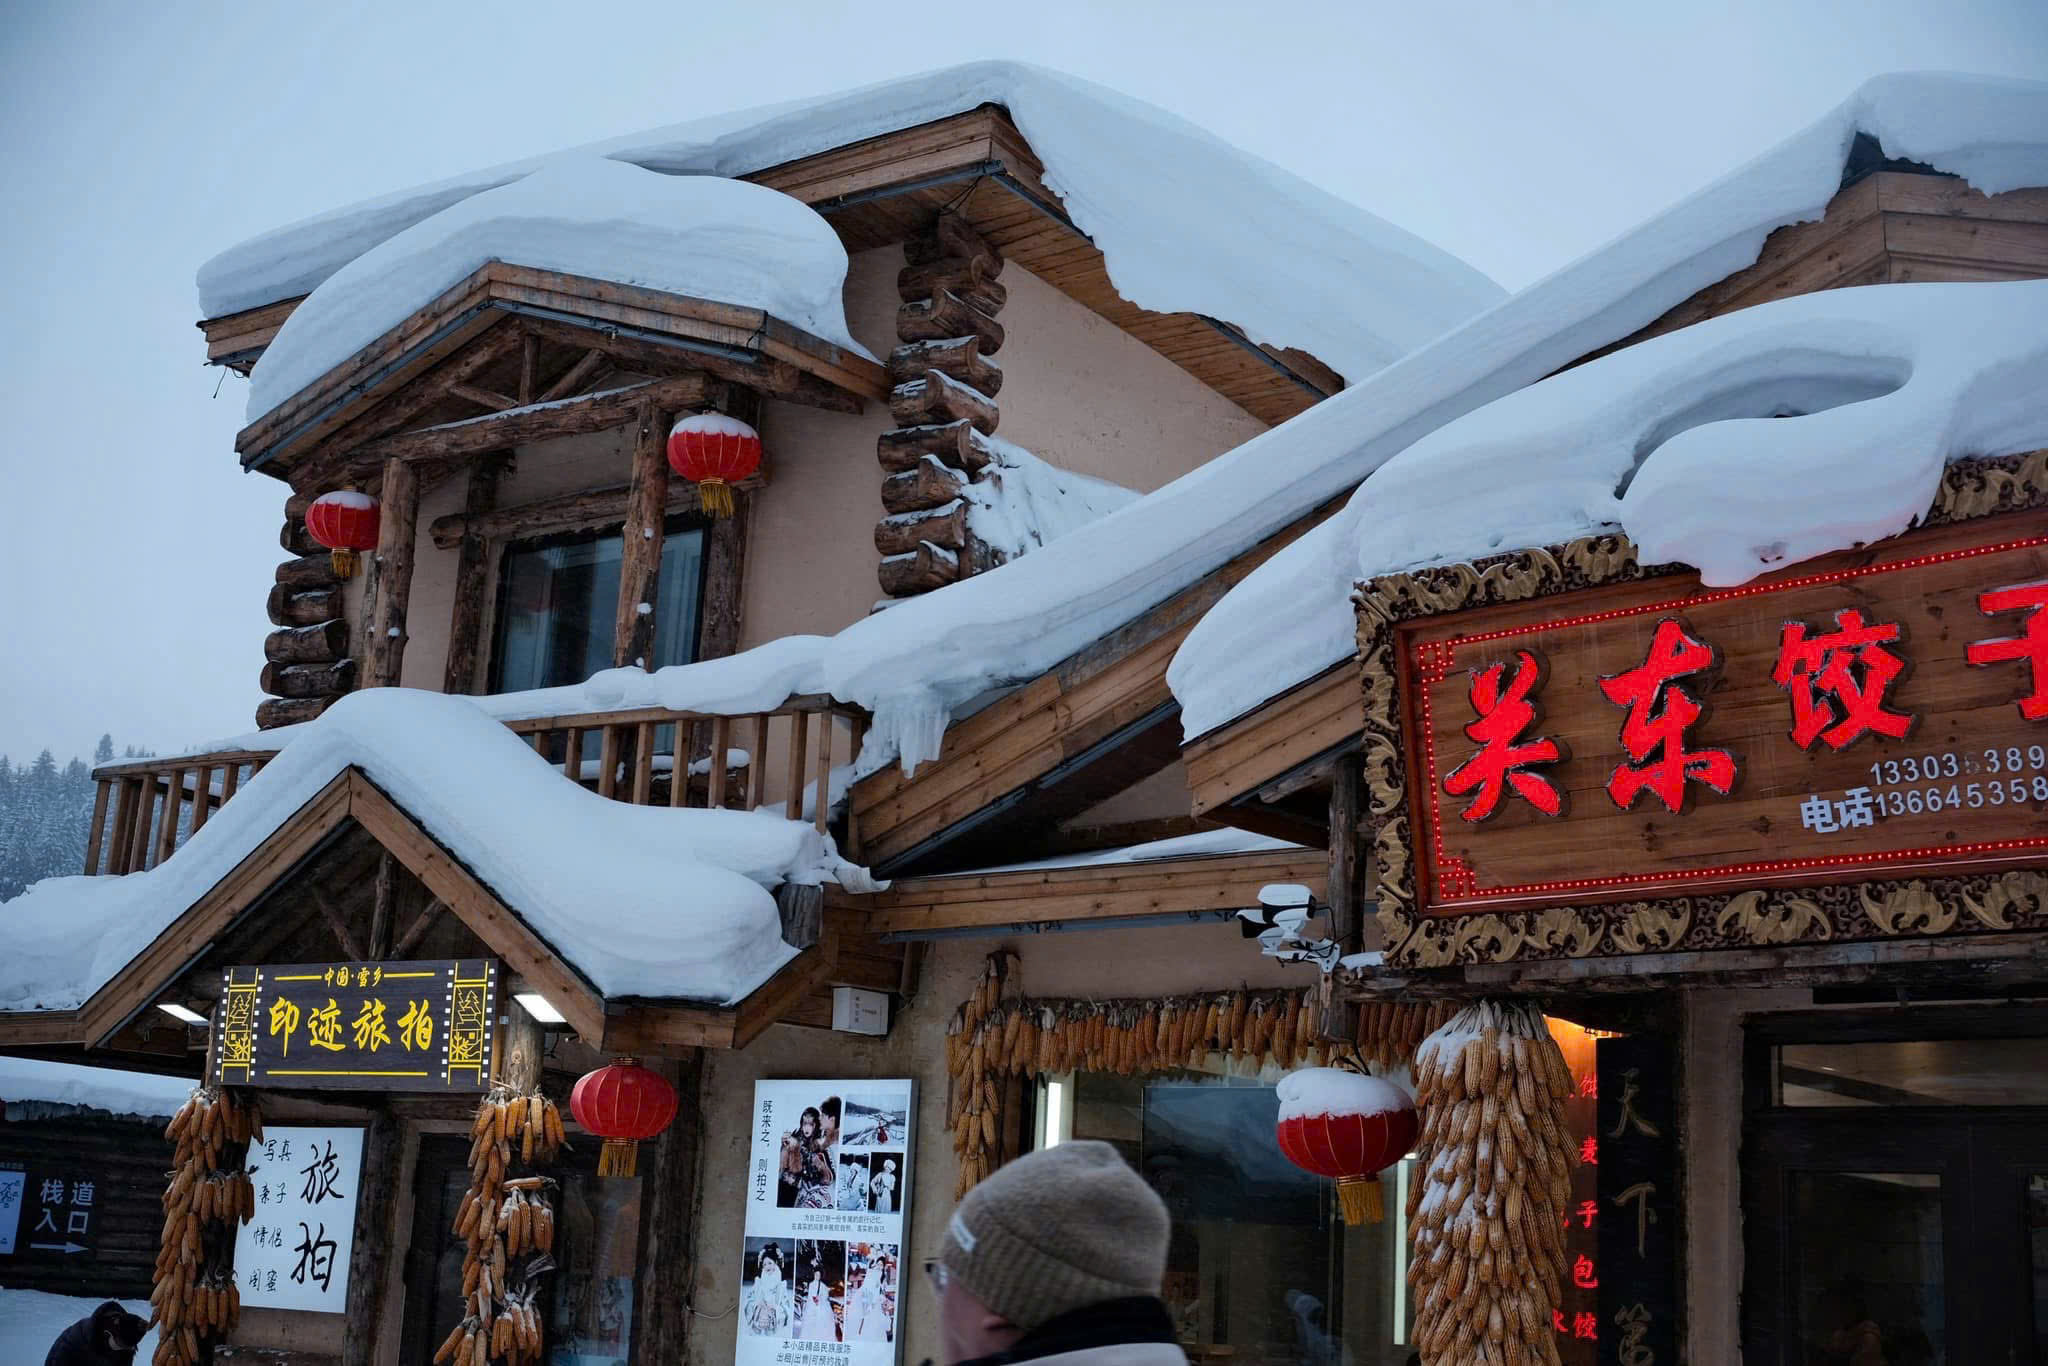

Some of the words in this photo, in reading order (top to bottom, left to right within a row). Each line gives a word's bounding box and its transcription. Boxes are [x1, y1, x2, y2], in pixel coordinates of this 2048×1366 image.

[269, 996, 434, 1058] 印迹旅拍
[264, 1139, 293, 1162] 写真
[40, 1179, 96, 1206] 栈道
[258, 1182, 287, 1204] 亲子
[34, 1208, 89, 1234] 入口
[290, 1140, 345, 1293] 旅拍
[253, 1226, 283, 1248] 情侣
